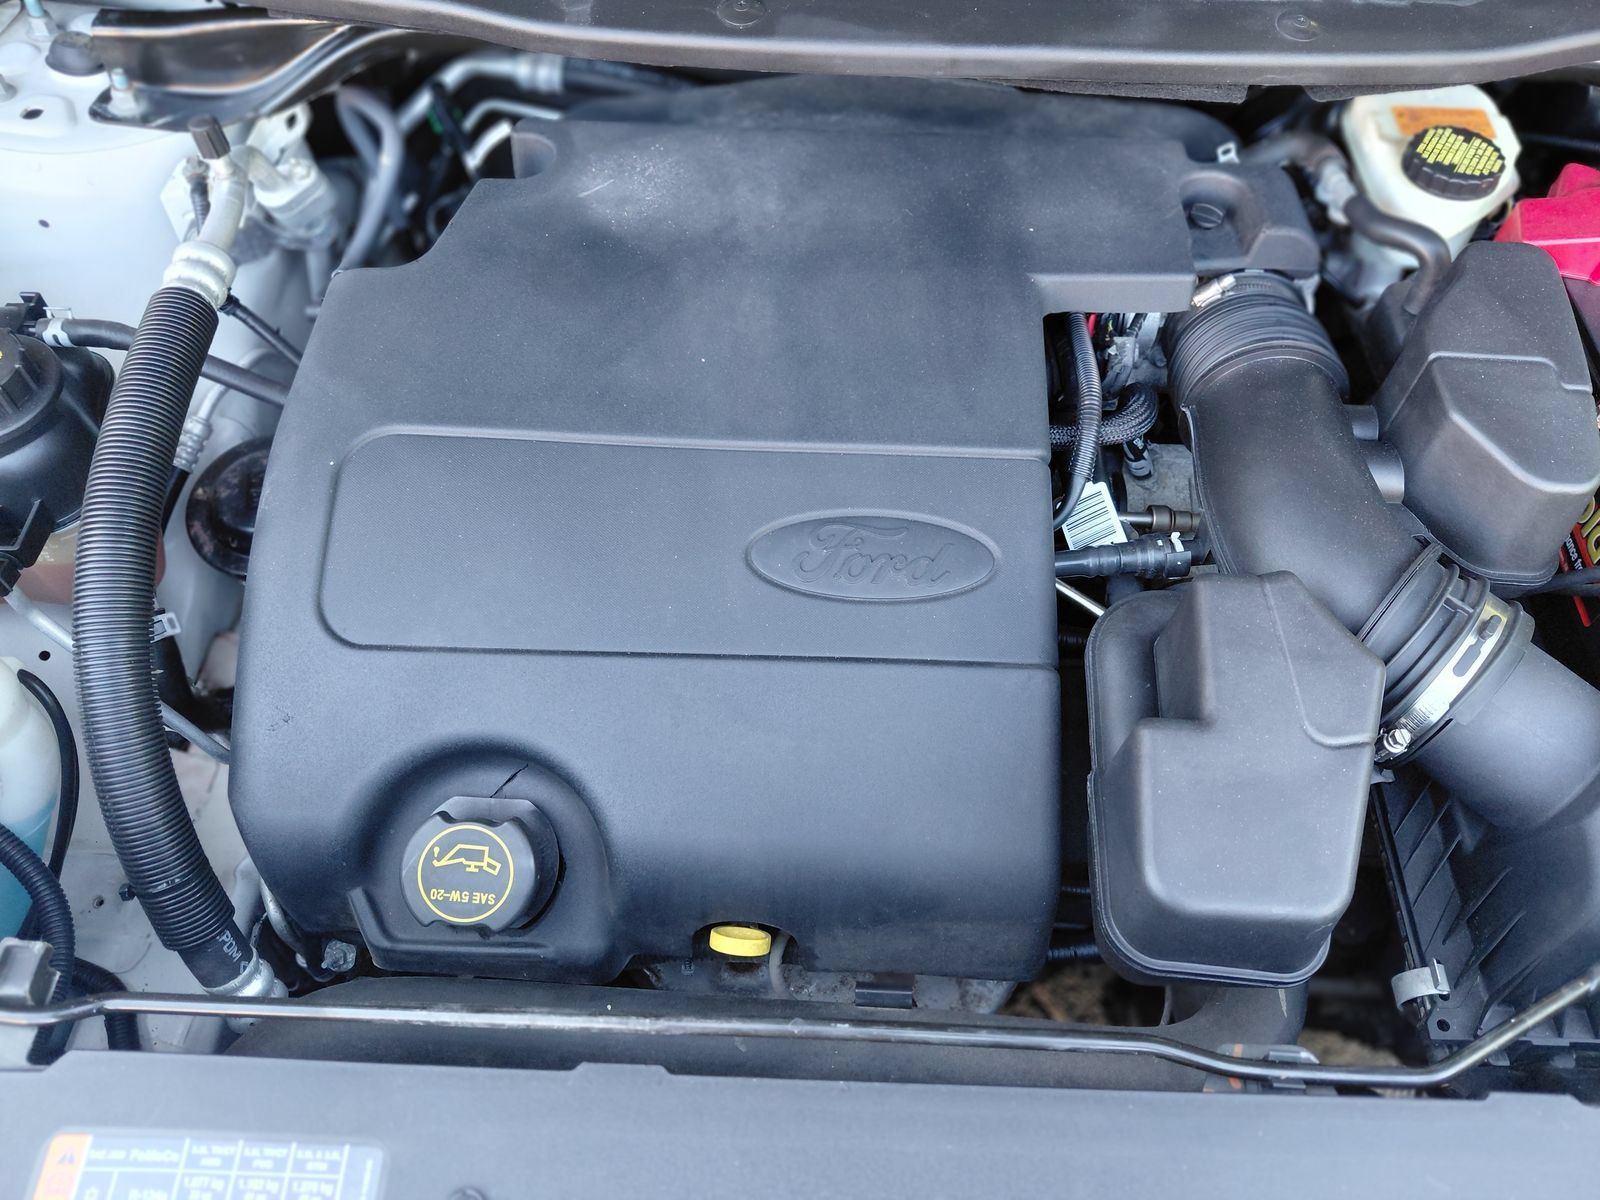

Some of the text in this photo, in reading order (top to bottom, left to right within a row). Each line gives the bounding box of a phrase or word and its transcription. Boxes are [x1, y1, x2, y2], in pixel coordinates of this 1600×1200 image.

[793, 521, 956, 586] Ford
[430, 888, 496, 905] SAE 5W-20
